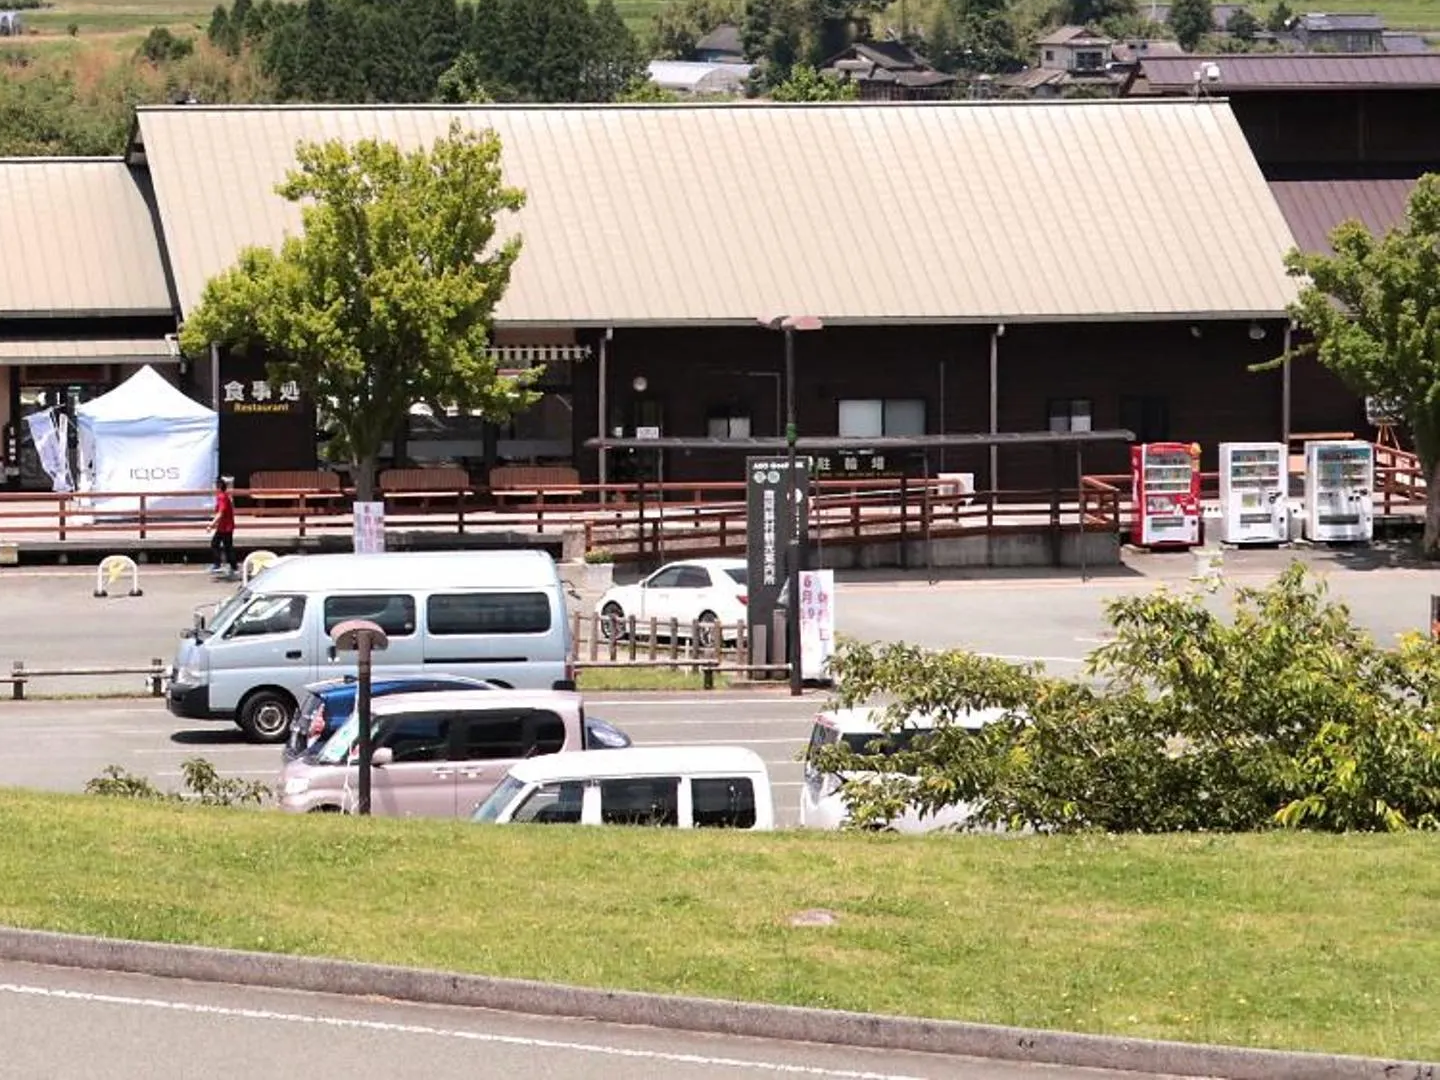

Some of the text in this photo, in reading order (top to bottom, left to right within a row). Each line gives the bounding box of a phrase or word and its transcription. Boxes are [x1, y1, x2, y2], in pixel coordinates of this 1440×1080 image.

[224, 380, 300, 401] 食事処
[233, 403, 289, 413] Restaurant
[130, 467, 181, 481] IQOS
